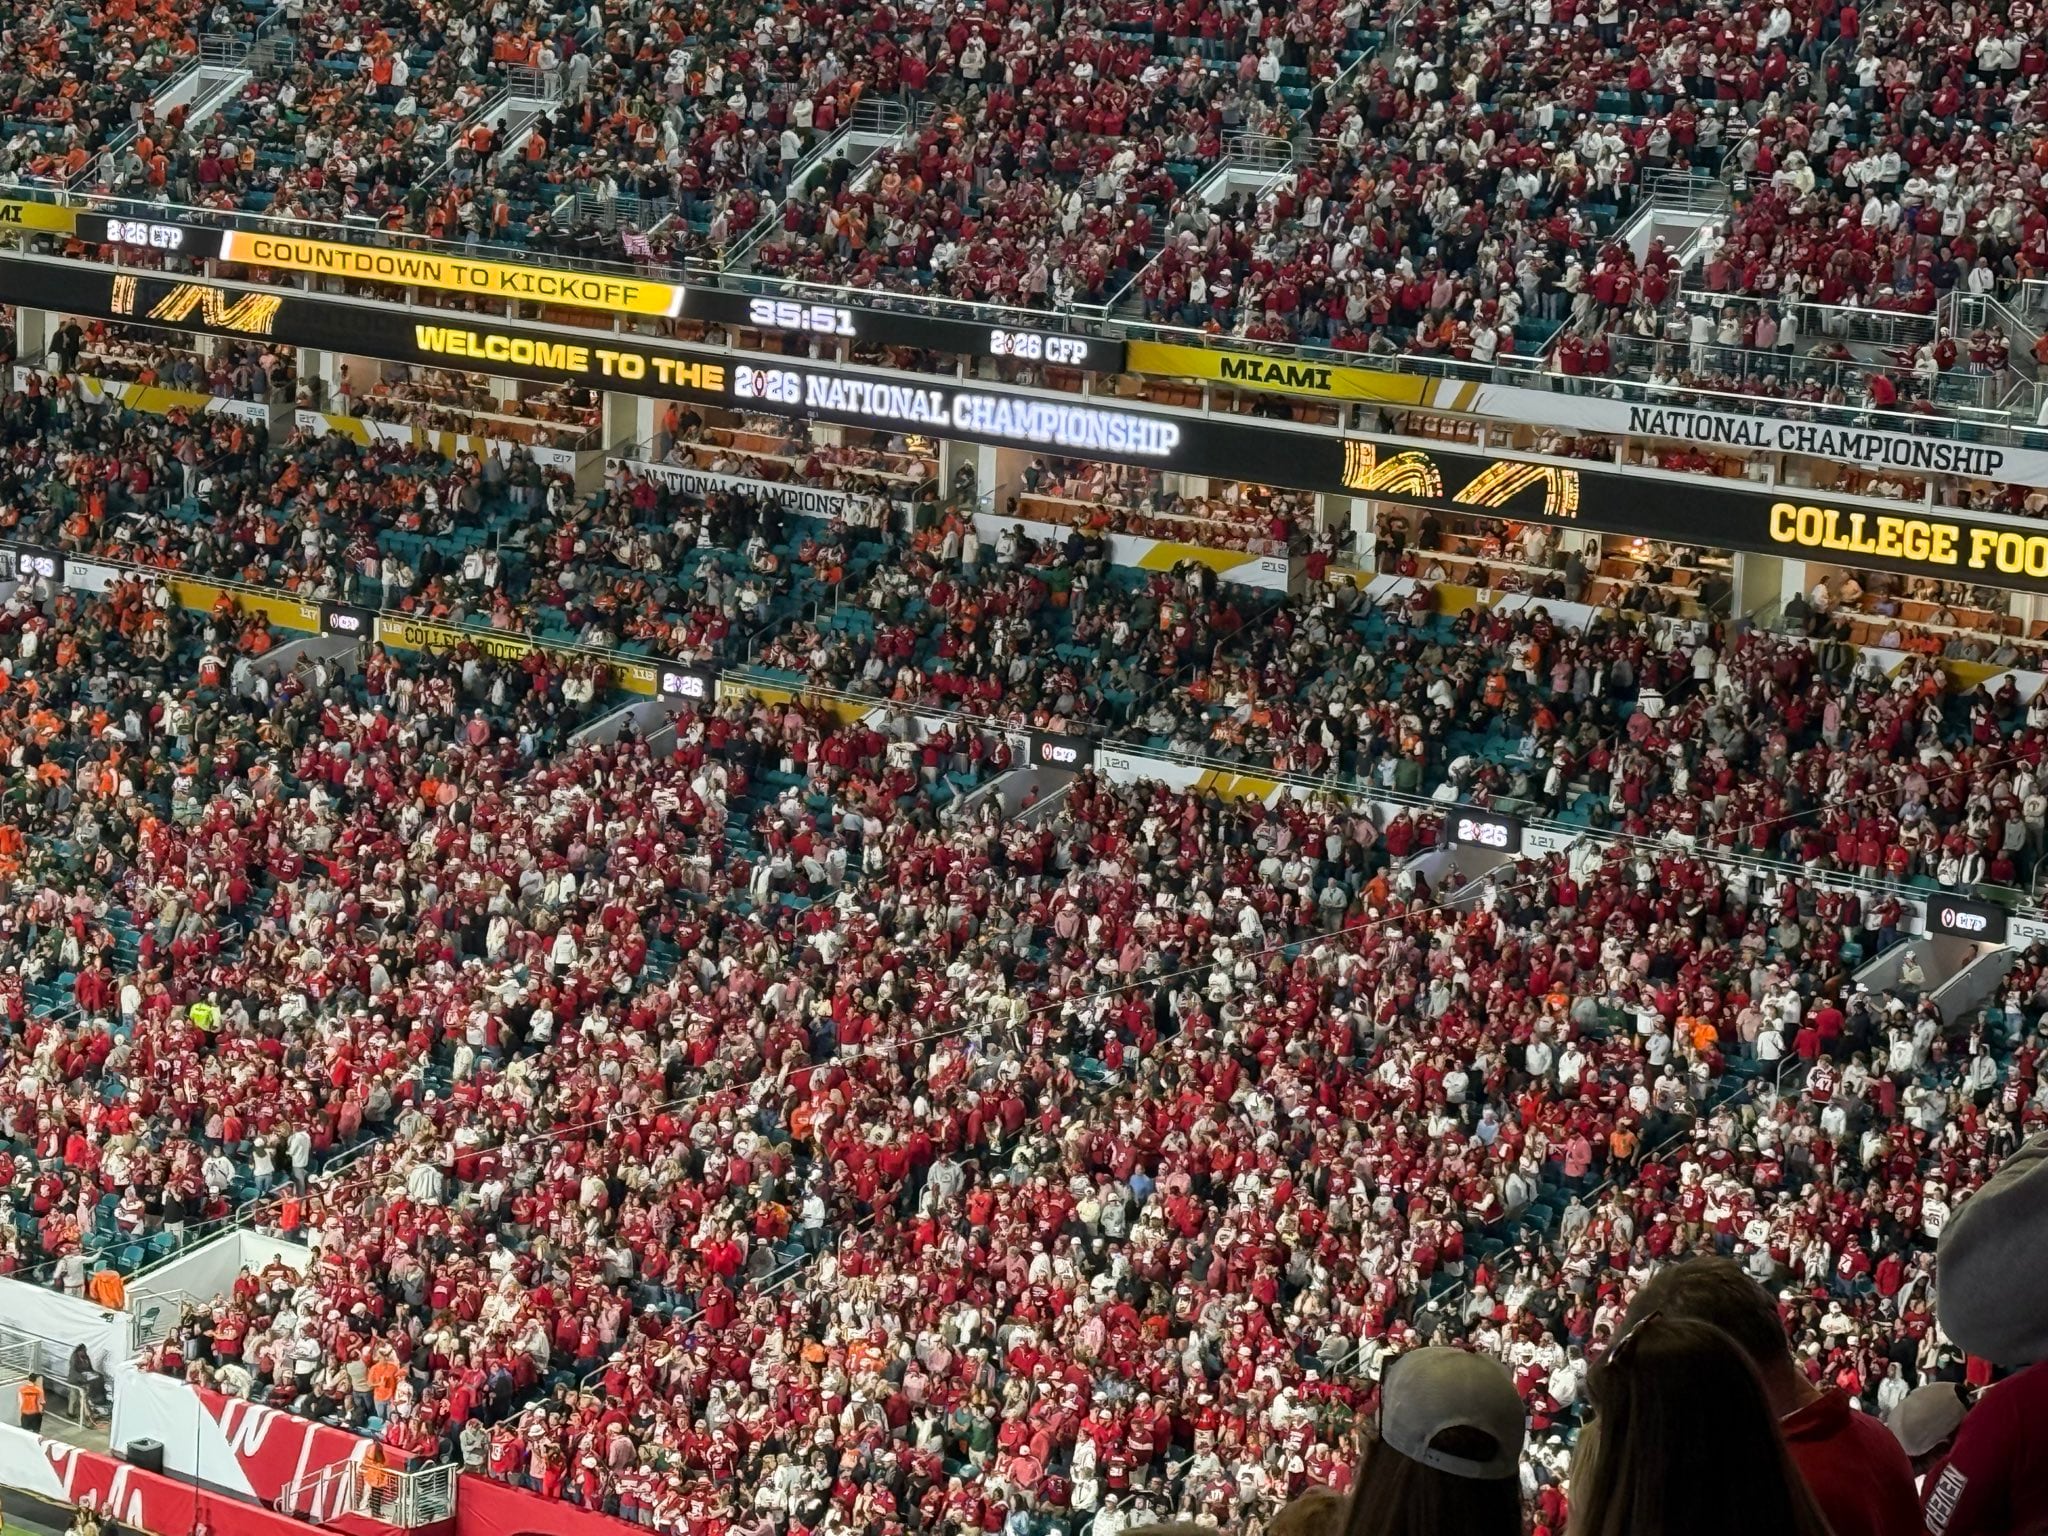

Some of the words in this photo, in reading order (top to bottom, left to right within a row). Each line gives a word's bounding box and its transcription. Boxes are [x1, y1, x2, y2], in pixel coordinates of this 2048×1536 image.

[254, 240, 441, 282] COUNTDOWN
[450, 265, 489, 286] TO
[500, 271, 640, 305] KICKOFF
[749, 299, 857, 336] 35:51
[990, 329, 1038, 359] 2026
[1045, 336, 1088, 365] CFP
[415, 325, 589, 373] WELCOME
[596, 349, 645, 379] TO
[652, 357, 725, 392] THE
[734, 366, 800, 404] 2026
[806, 375, 950, 426] NATIONAL
[953, 394, 1180, 455] CHAMPIONSHIP
[1220, 357, 1332, 391] MIAMI
[1628, 406, 1772, 448] NATIONAL
[1778, 424, 2004, 476] CHAMPIONSHIP
[644, 468, 730, 494] NTIONAL
[1770, 503, 1959, 566] COLLEGE
[1968, 528, 2048, 577] FOO
[1261, 561, 1288, 574] 219
[663, 673, 703, 697] 2026
[1104, 756, 1130, 770] 120
[1458, 819, 1508, 847] 2026
[1530, 834, 1556, 849] 121
[1925, 1462, 1969, 1528] NEVER
